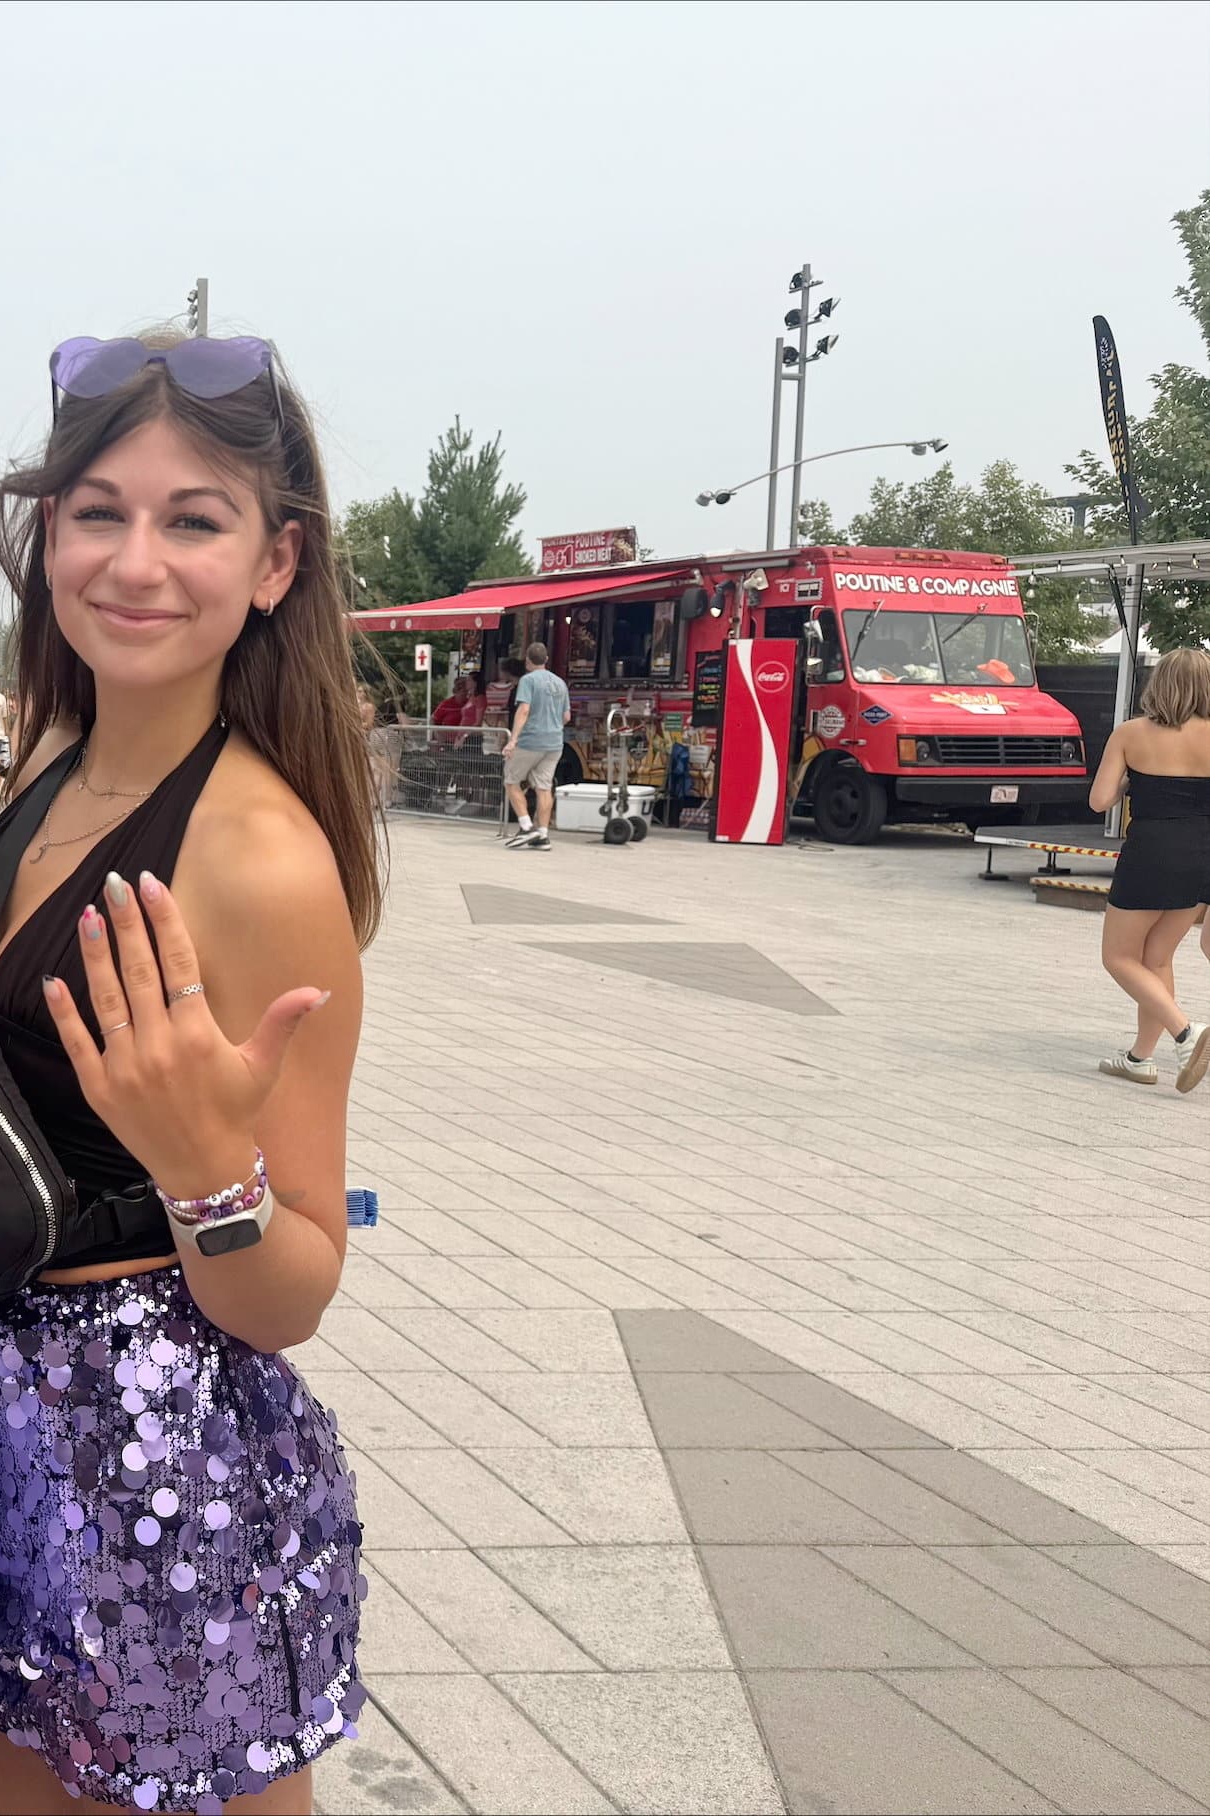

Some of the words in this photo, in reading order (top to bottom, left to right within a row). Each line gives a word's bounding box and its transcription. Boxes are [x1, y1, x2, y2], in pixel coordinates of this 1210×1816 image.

[575, 532, 606, 548] POUTINE
[835, 573, 906, 593] POUTINE
[908, 579, 920, 593] &
[921, 578, 1018, 596] COMPAGNIE
